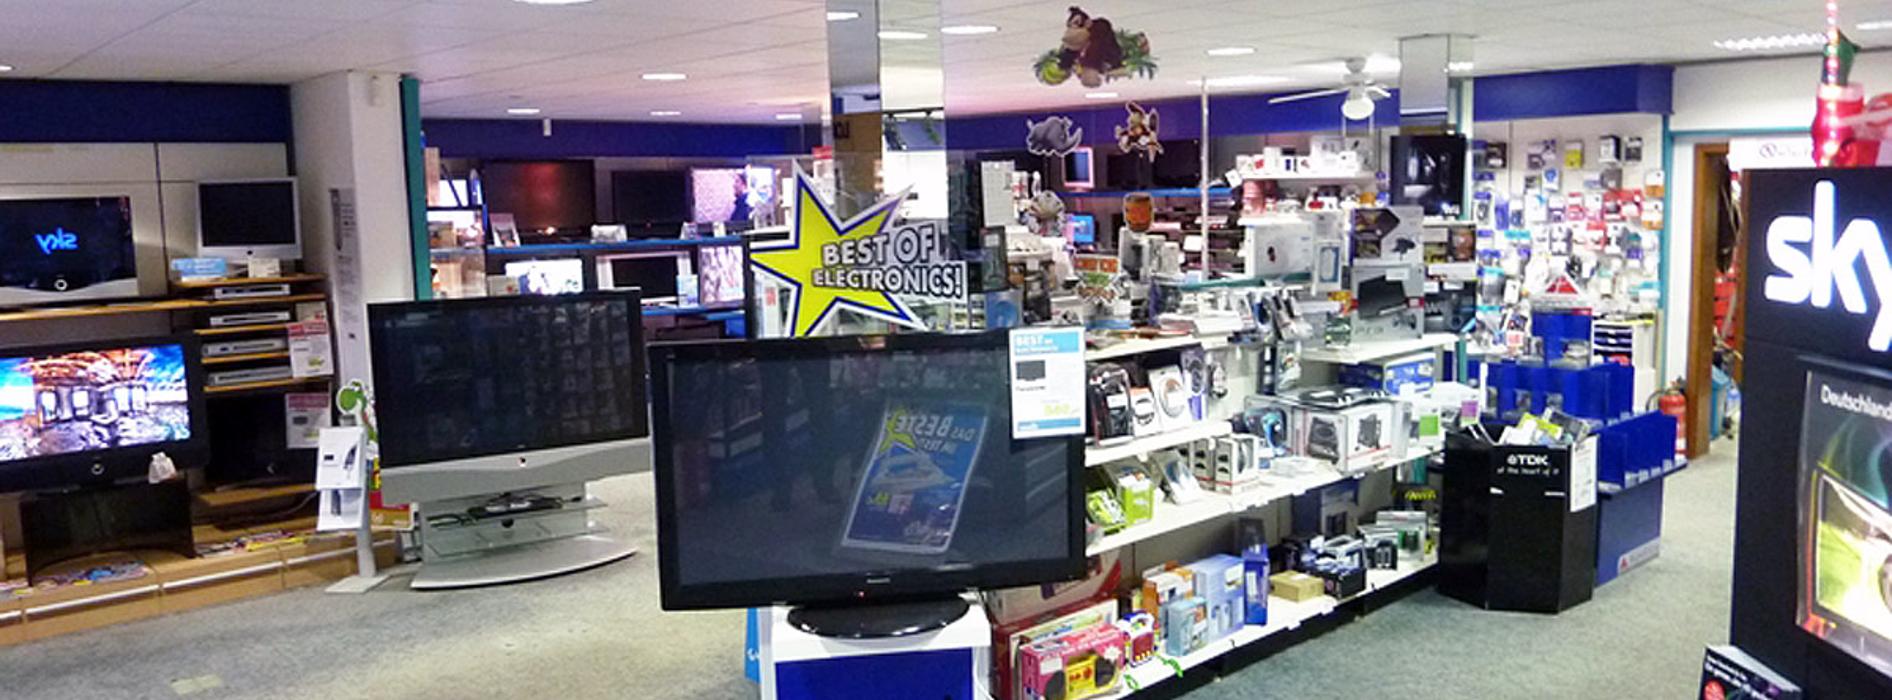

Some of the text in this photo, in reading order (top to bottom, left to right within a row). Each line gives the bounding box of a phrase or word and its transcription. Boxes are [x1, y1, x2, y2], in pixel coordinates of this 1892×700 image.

[821, 224, 934, 267] BEST OF
[812, 265, 963, 297] ELECTRONICS!
[1516, 454, 1549, 466] TDK
